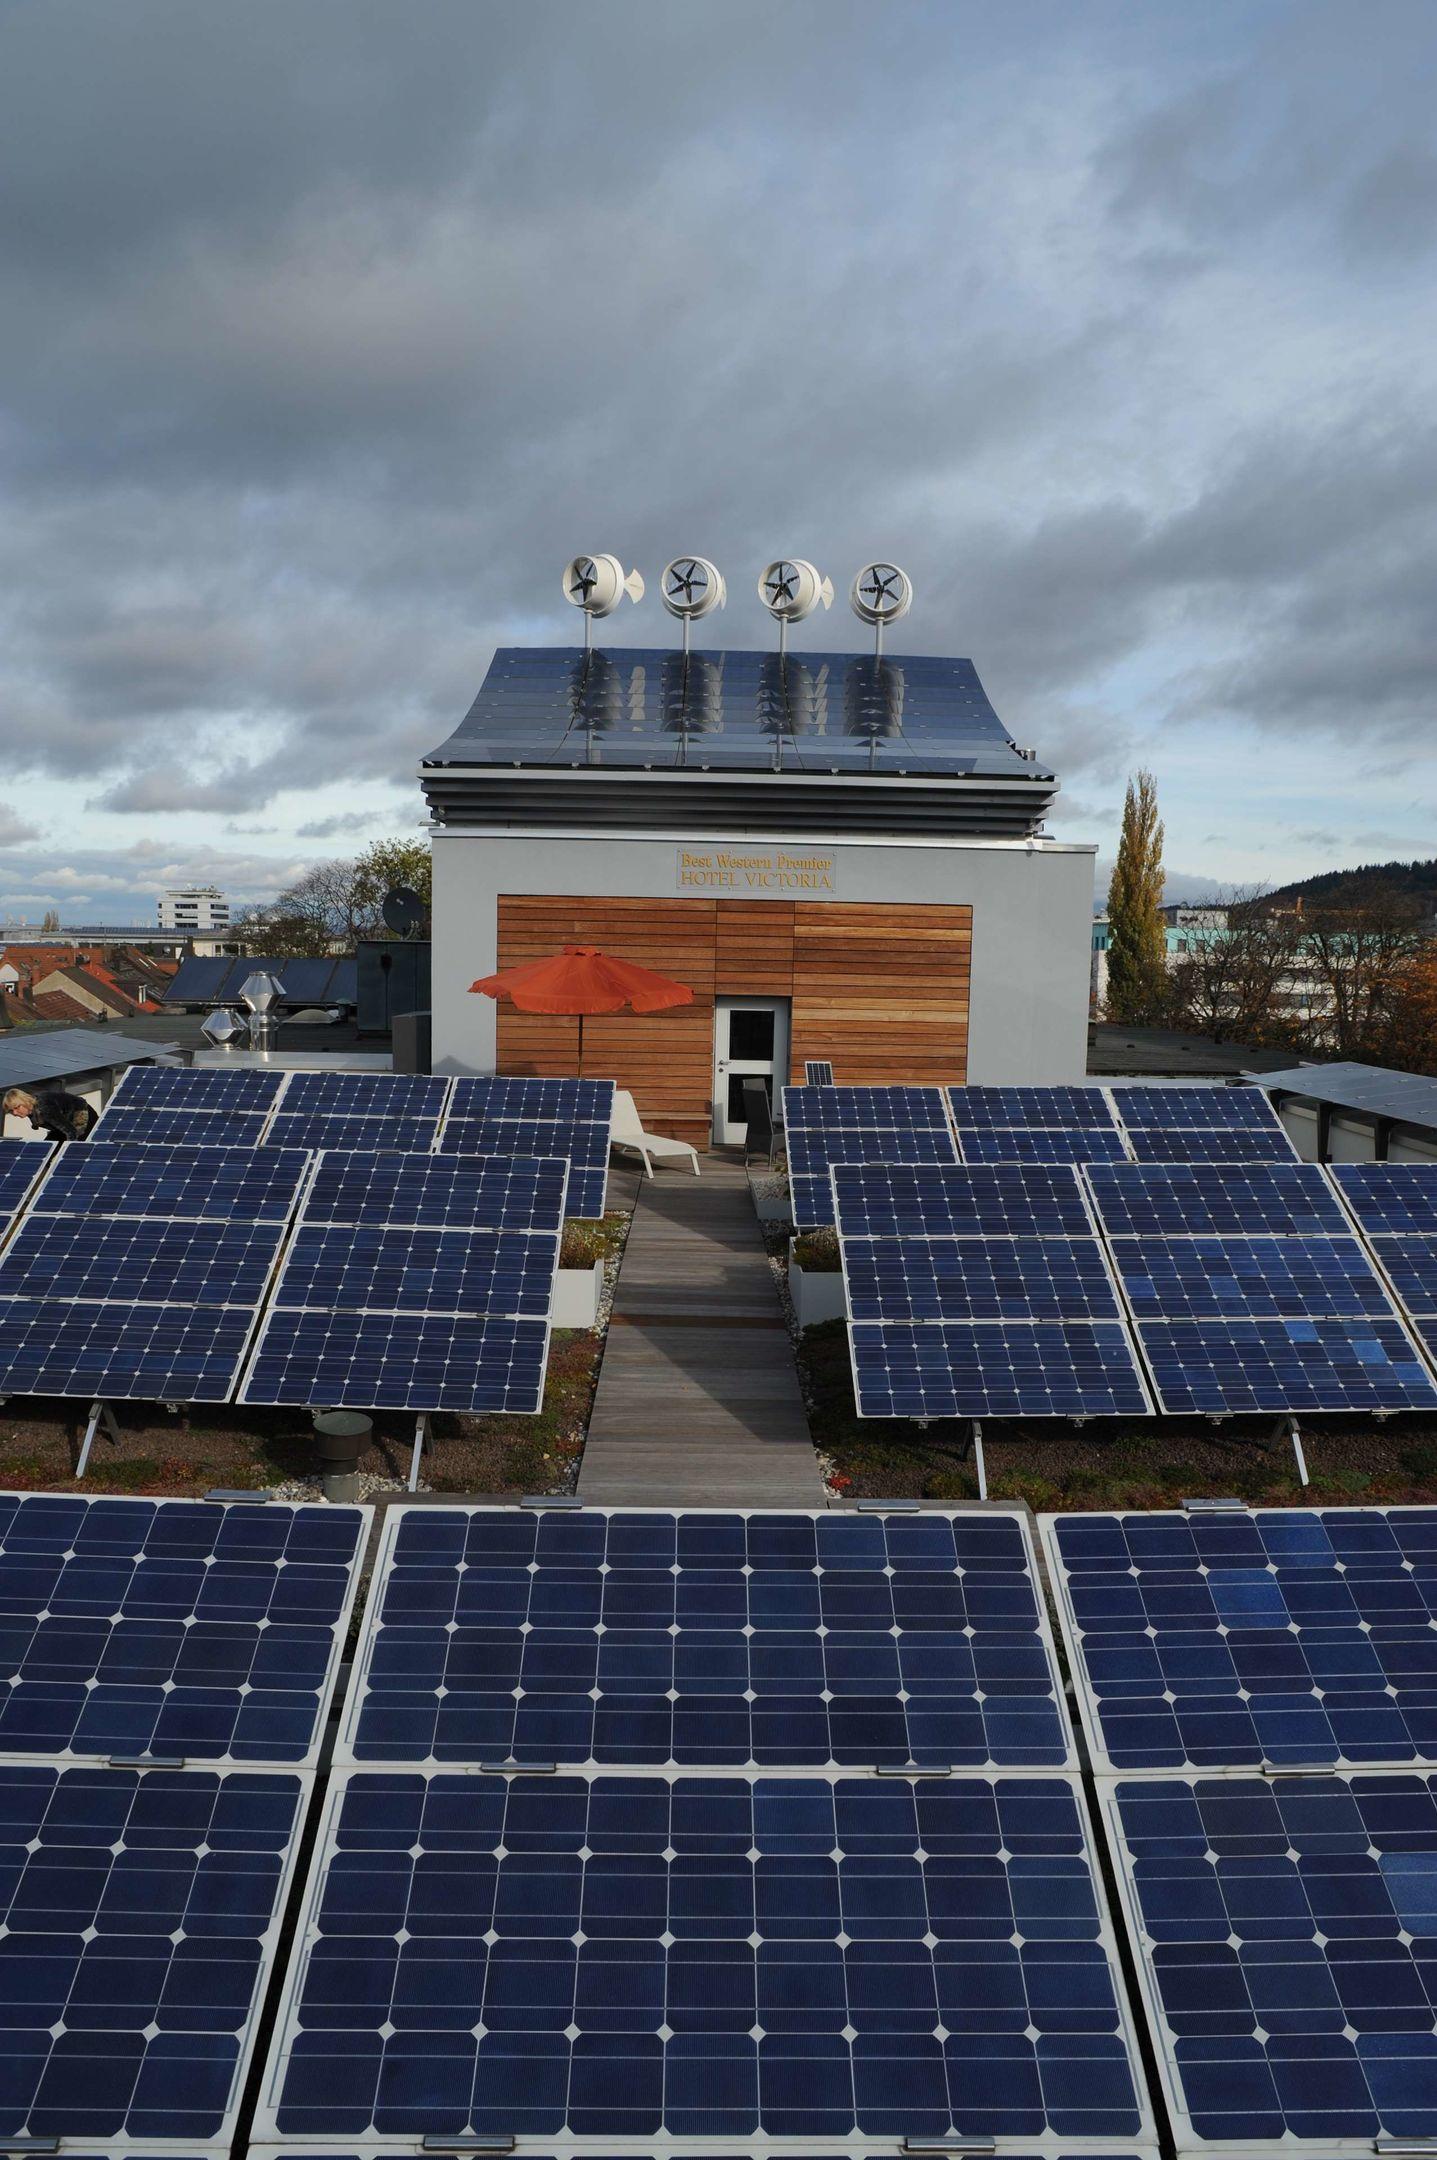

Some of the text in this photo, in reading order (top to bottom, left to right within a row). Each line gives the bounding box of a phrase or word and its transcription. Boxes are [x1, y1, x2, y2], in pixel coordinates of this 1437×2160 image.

[681, 853, 832, 870] Best Western Premier
[681, 871, 832, 888] HOTEL VICTORIA
